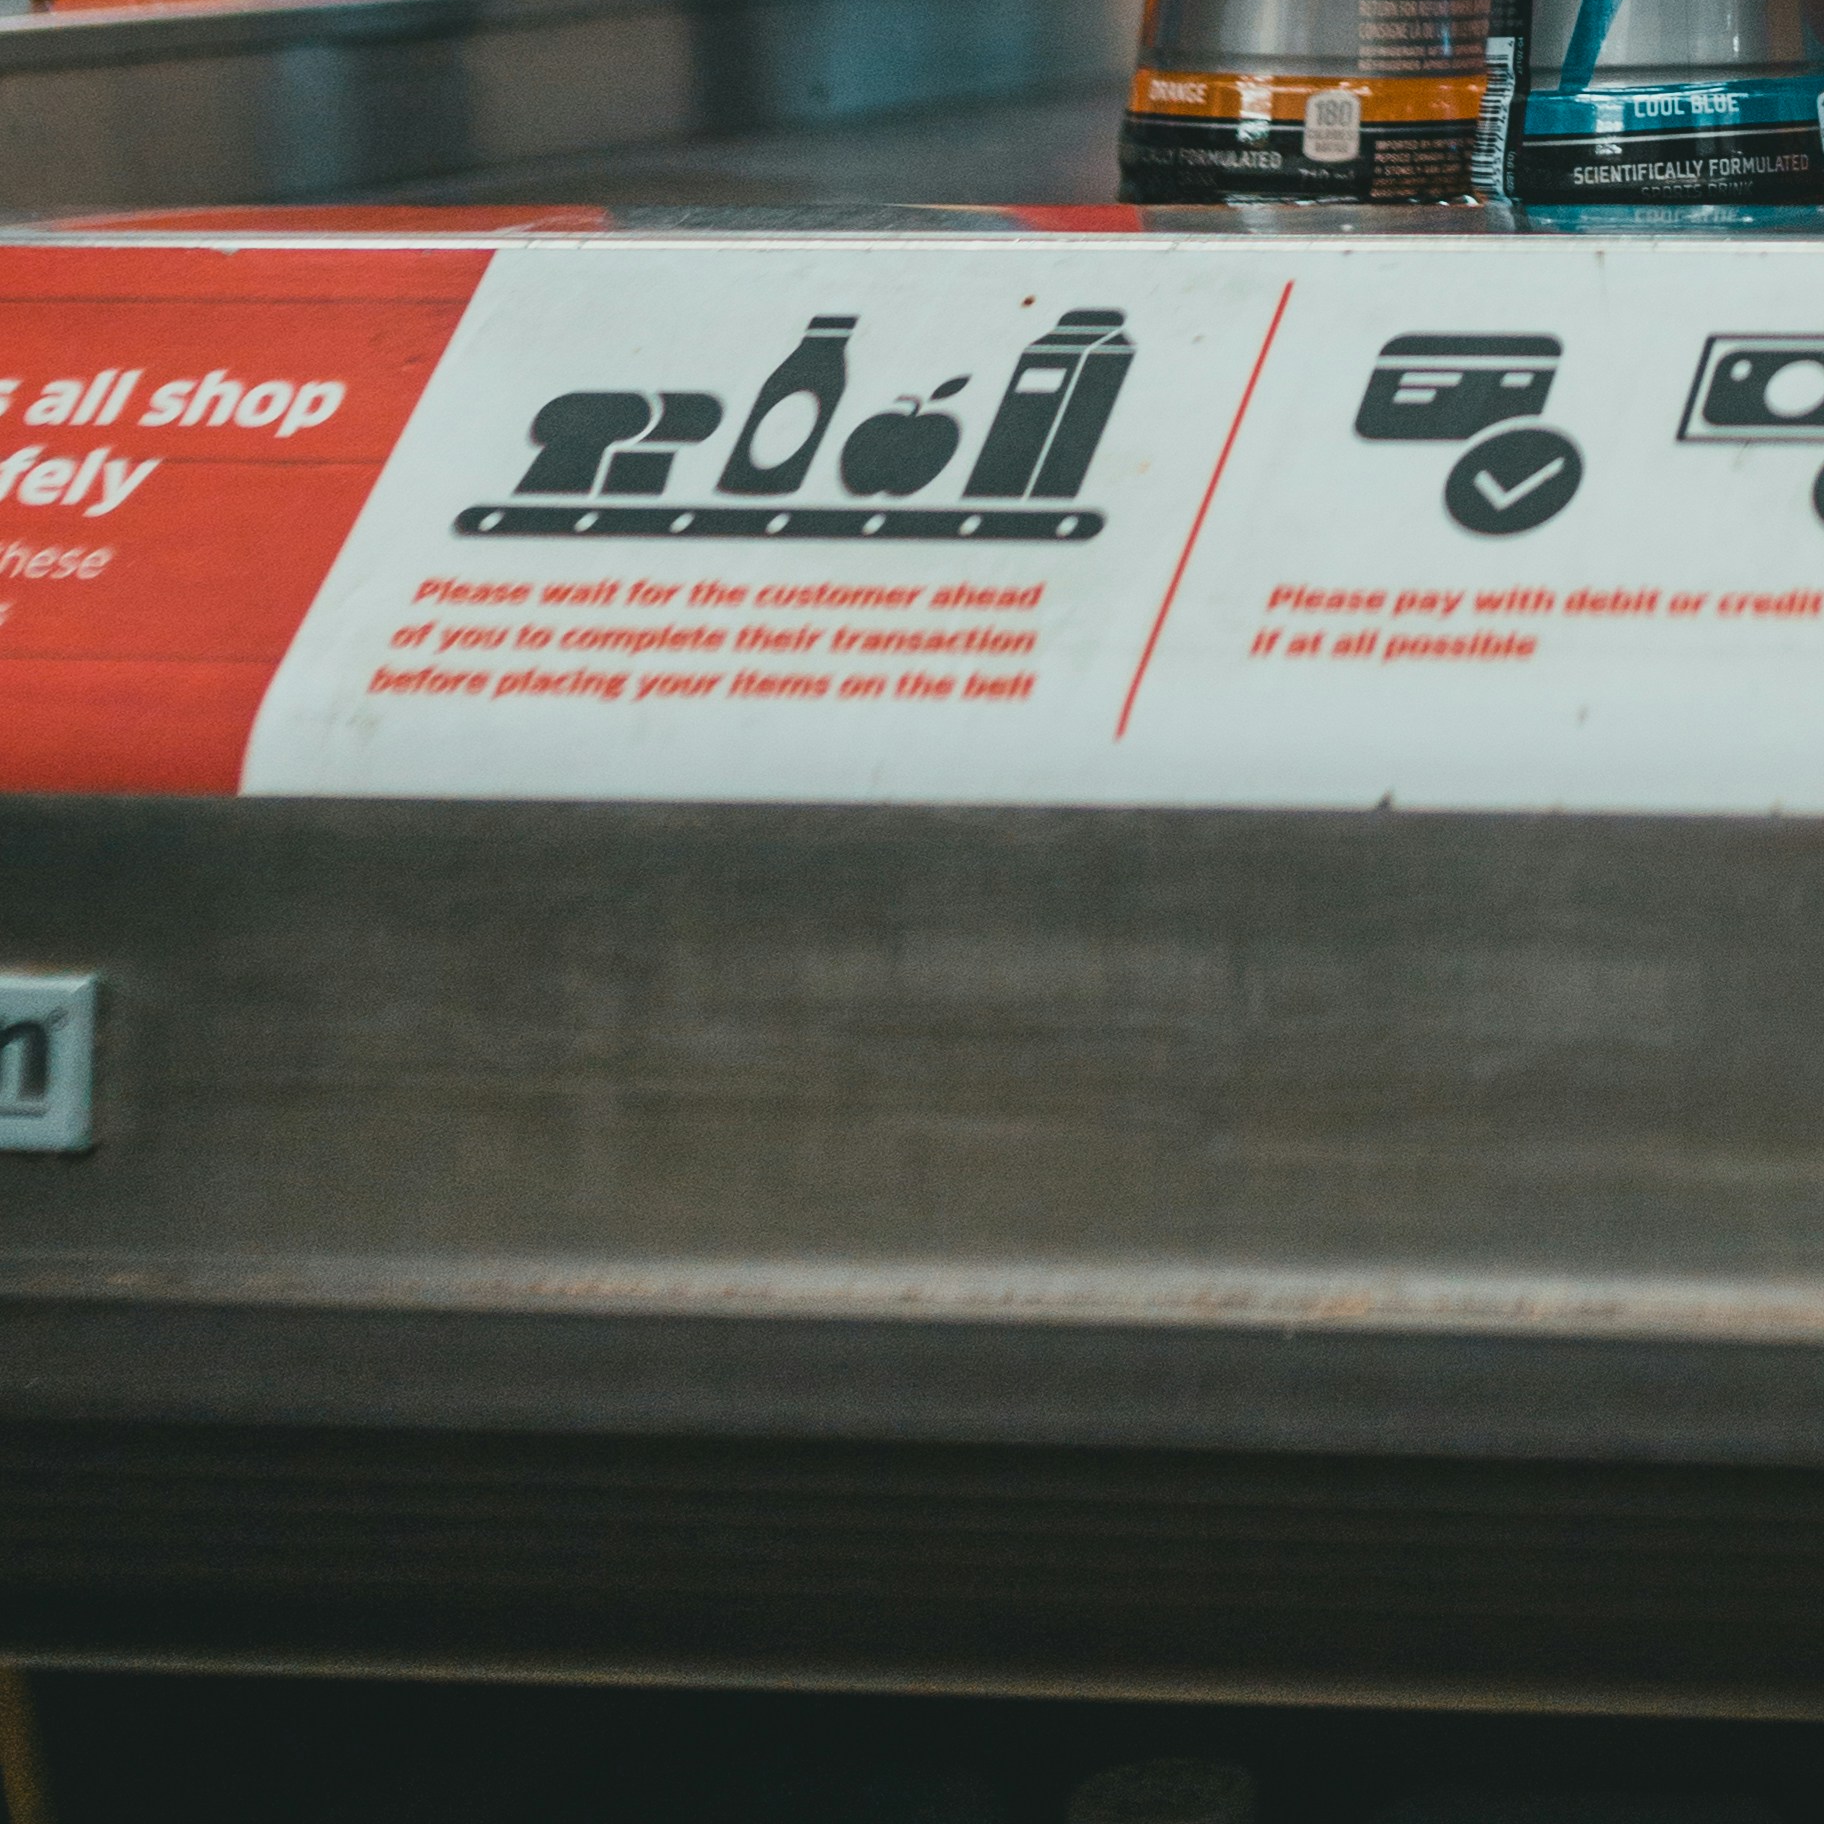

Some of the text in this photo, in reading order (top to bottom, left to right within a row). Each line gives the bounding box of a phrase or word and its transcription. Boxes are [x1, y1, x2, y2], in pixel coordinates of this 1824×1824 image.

[1634, 92, 1740, 118] COOL BLUE
[1573, 154, 1809, 186] SCIENTIFICALLY FORMULATED
[23, 368, 347, 438] all shop
[412, 577, 1047, 611] Please wait for the customer ahead
[1266, 584, 1390, 614] Please
[1391, 588, 1464, 621] pay
[1472, 582, 1557, 614] with
[1563, 586, 1661, 618] debit
[1668, 591, 1709, 618] or
[1716, 588, 1824, 619] credit
[388, 619, 1038, 657] of you to complete their transaction
[1284, 631, 1325, 660] at
[1331, 628, 1381, 659] all
[1382, 629, 1539, 666] possible
[365, 663, 1037, 703] before placing your items on the belt
